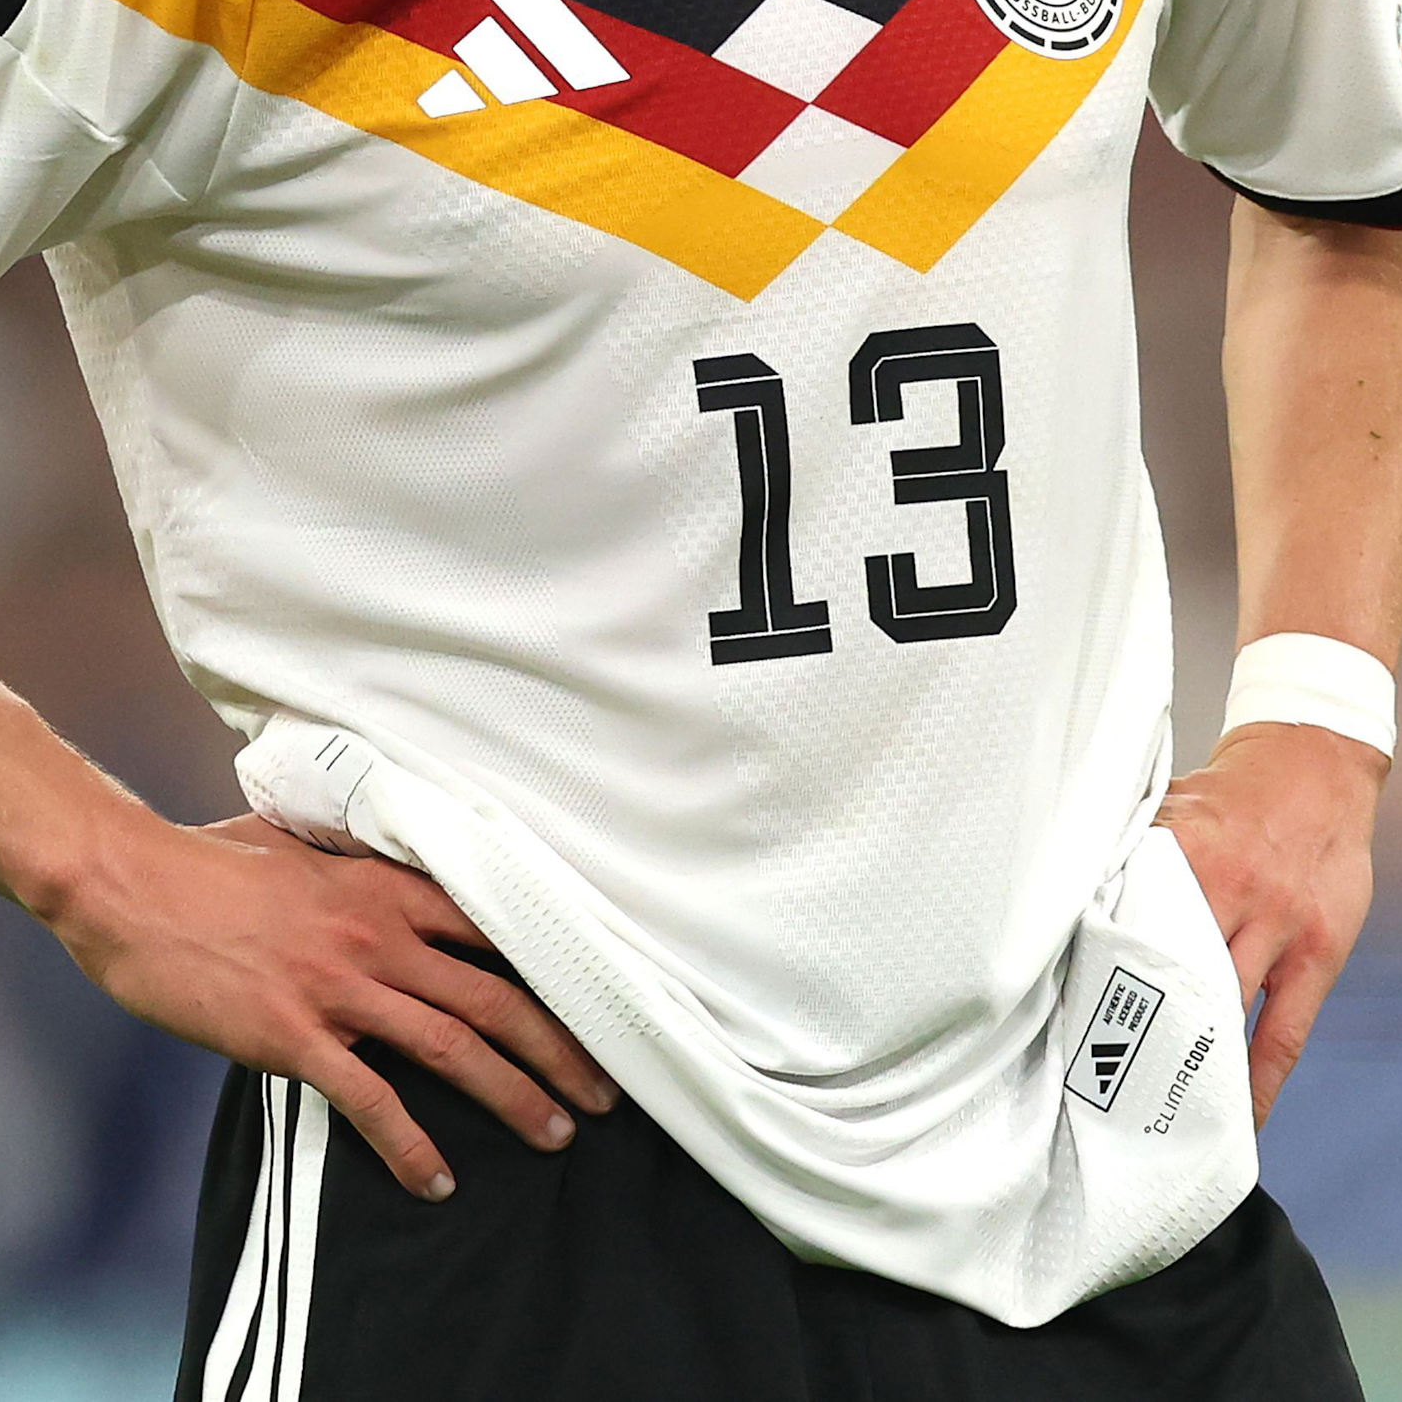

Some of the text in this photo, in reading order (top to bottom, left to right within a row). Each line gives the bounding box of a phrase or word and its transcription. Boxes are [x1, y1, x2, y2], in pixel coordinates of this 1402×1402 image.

[693, 323, 1017, 665] 13
[1102, 982, 1126, 1025] AUTHENTIC
[1116, 990, 1138, 1026] LICENSED
[1128, 997, 1150, 1032] PRODUCT
